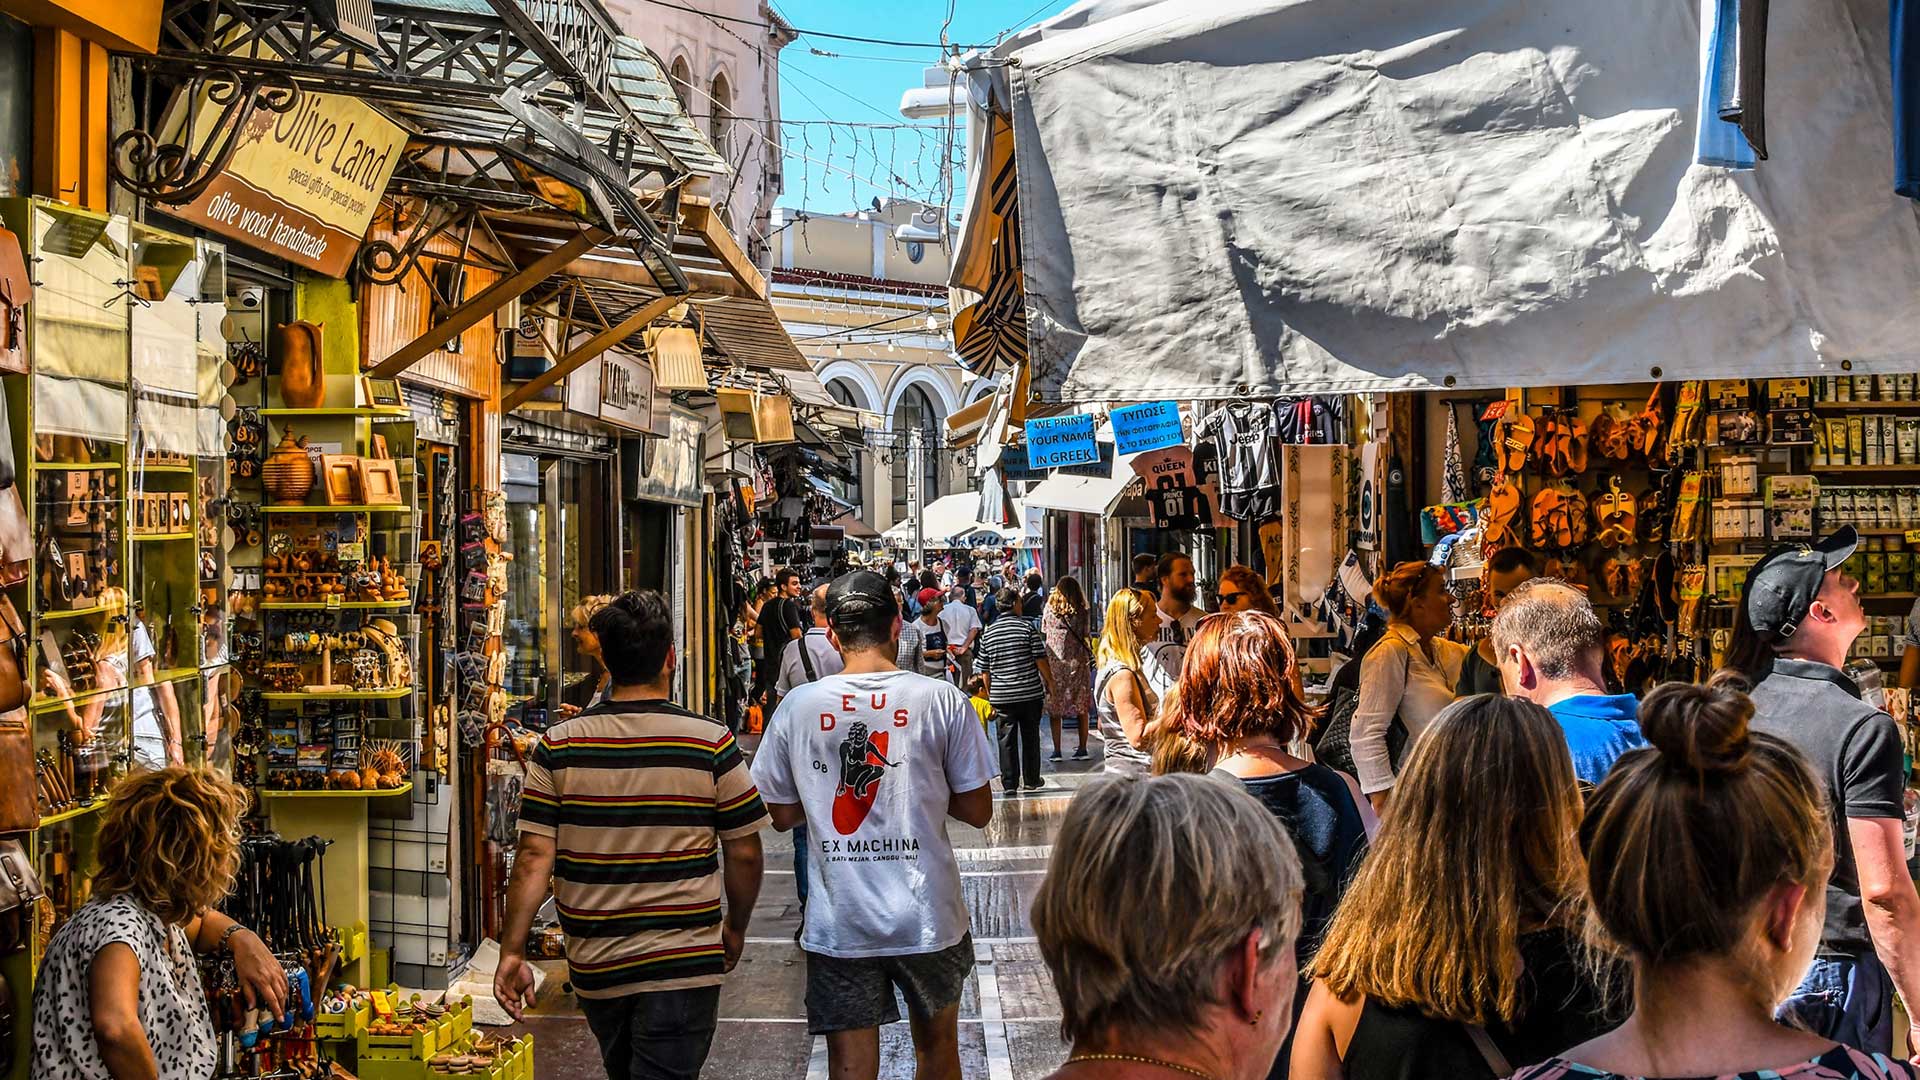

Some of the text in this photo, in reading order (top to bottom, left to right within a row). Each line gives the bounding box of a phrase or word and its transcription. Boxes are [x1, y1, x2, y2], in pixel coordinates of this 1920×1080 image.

[274, 91, 393, 193] Olive Land
[288, 168, 367, 216] special gifts for special people
[207, 192, 328, 262] olive wood handmade
[1121, 405, 1166, 422] ΤΥΠΩΣΕ
[1034, 416, 1084, 430] WE PRINT
[1030, 431, 1095, 446] YOUR NAME
[1229, 432, 1260, 445] Jeep
[1036, 455, 1047, 465] IN
[1050, 449, 1092, 463] GREEK
[1152, 461, 1186, 474] QUEEN
[1165, 497, 1185, 517] 01
[820, 693, 908, 732] DEUS
[812, 760, 828, 774] 08
[822, 838, 920, 853] EX MACHINA
